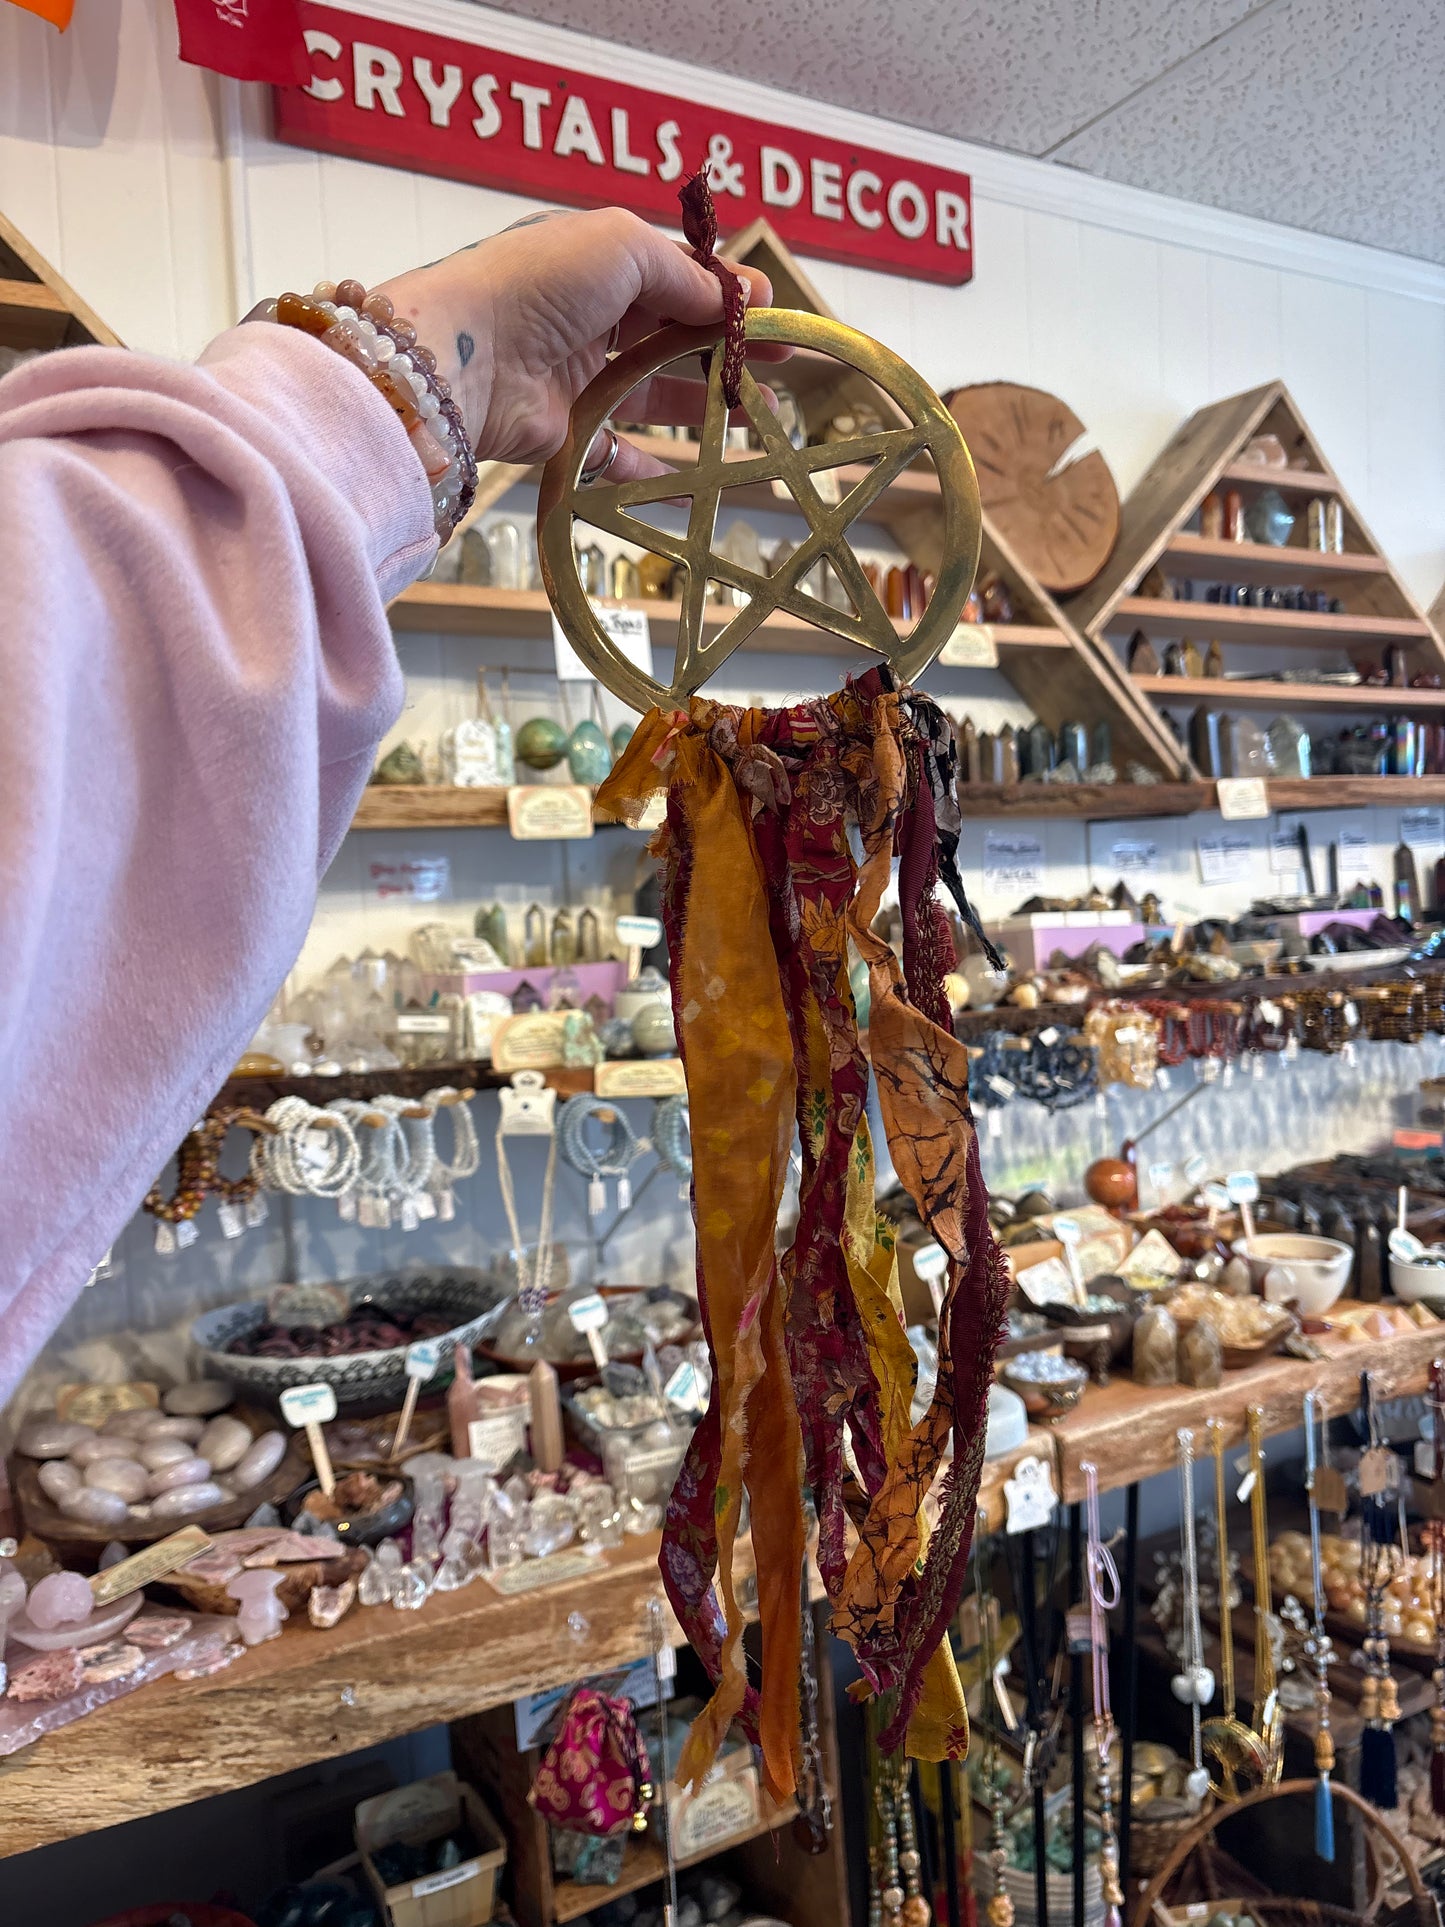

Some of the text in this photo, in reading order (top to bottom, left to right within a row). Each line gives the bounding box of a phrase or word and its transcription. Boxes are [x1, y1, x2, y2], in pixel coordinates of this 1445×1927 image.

[302, 29, 970, 250] CRYSTALS & DECOR
